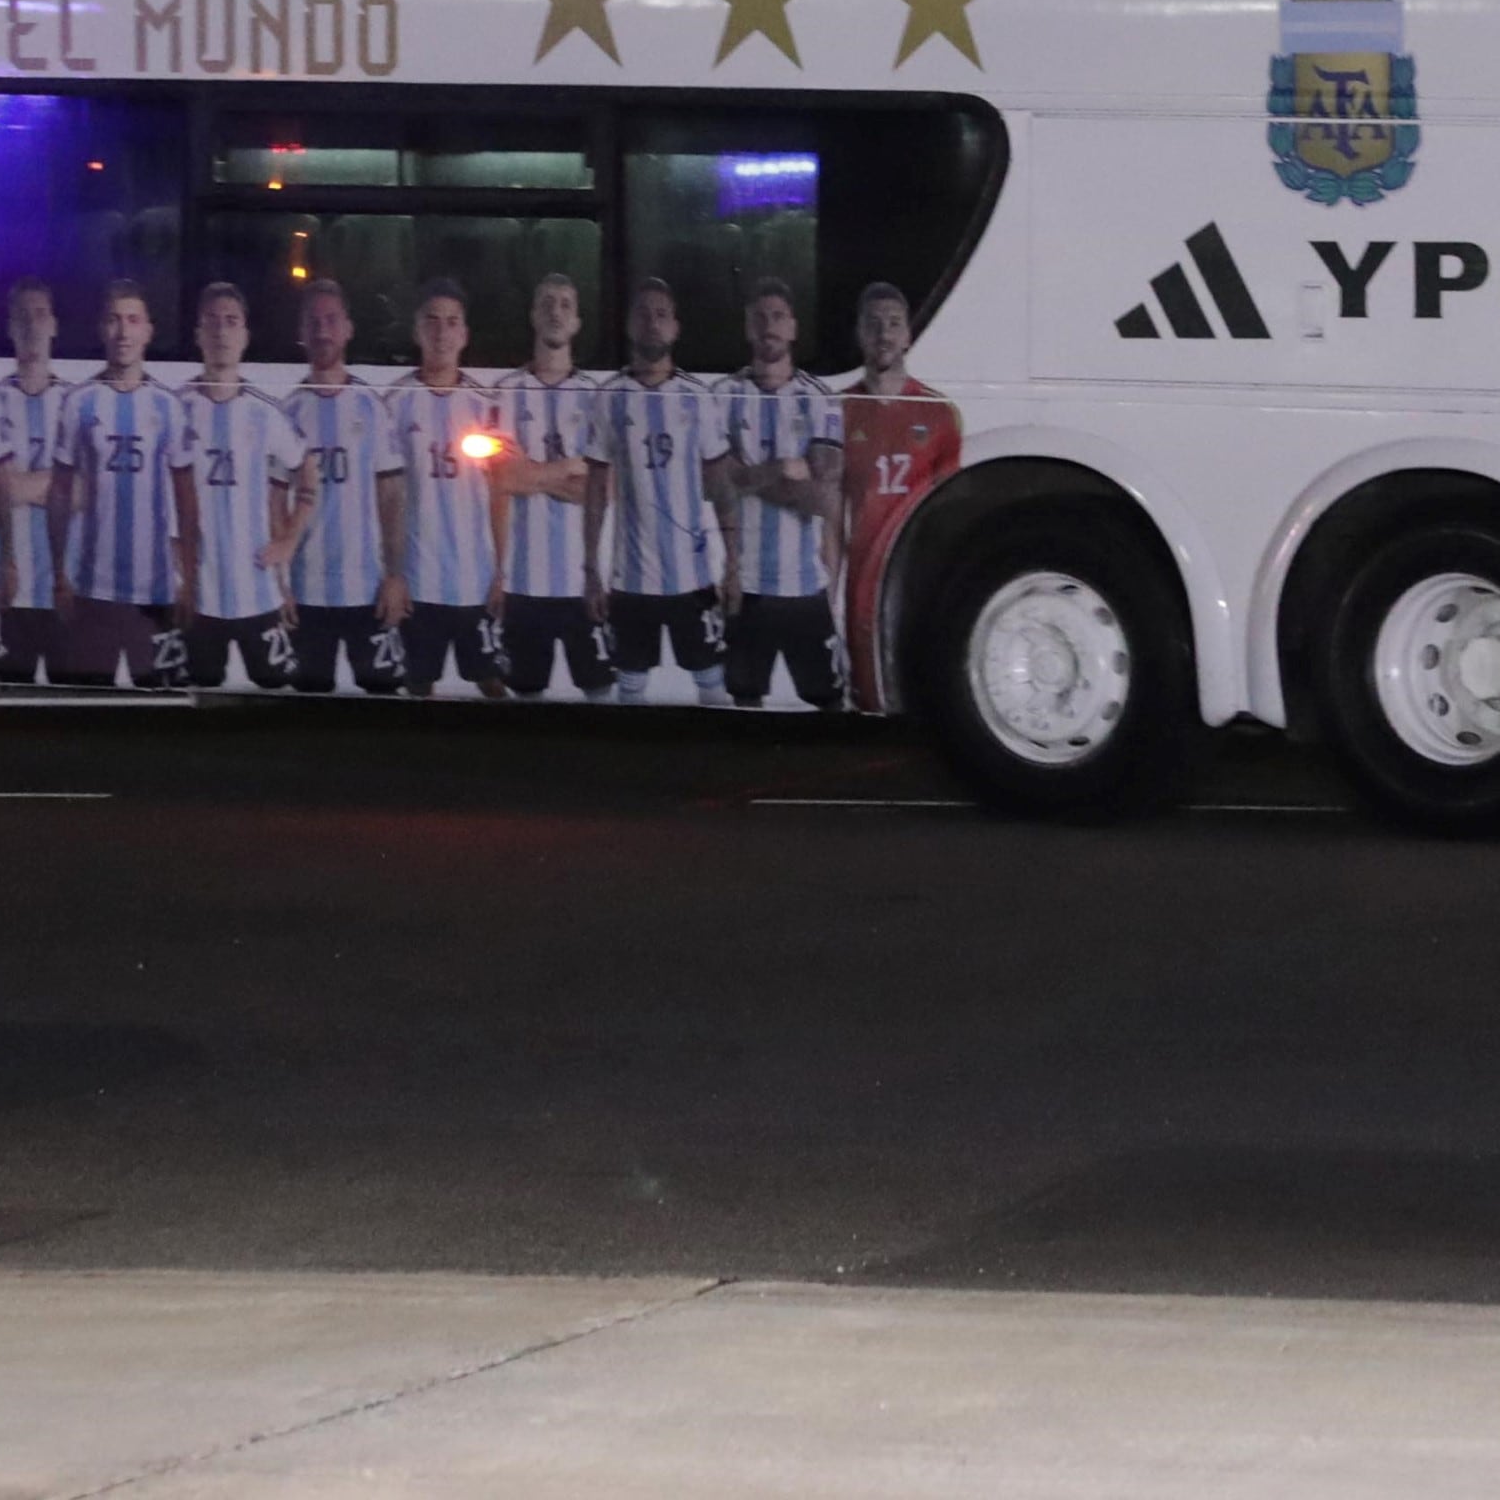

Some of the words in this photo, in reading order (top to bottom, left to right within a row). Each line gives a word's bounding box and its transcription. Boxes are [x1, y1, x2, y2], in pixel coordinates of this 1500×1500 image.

[104, 433, 144, 473] 25
[205, 448, 238, 486] 21
[643, 432, 674, 470] 19
[875, 453, 912, 495] 12
